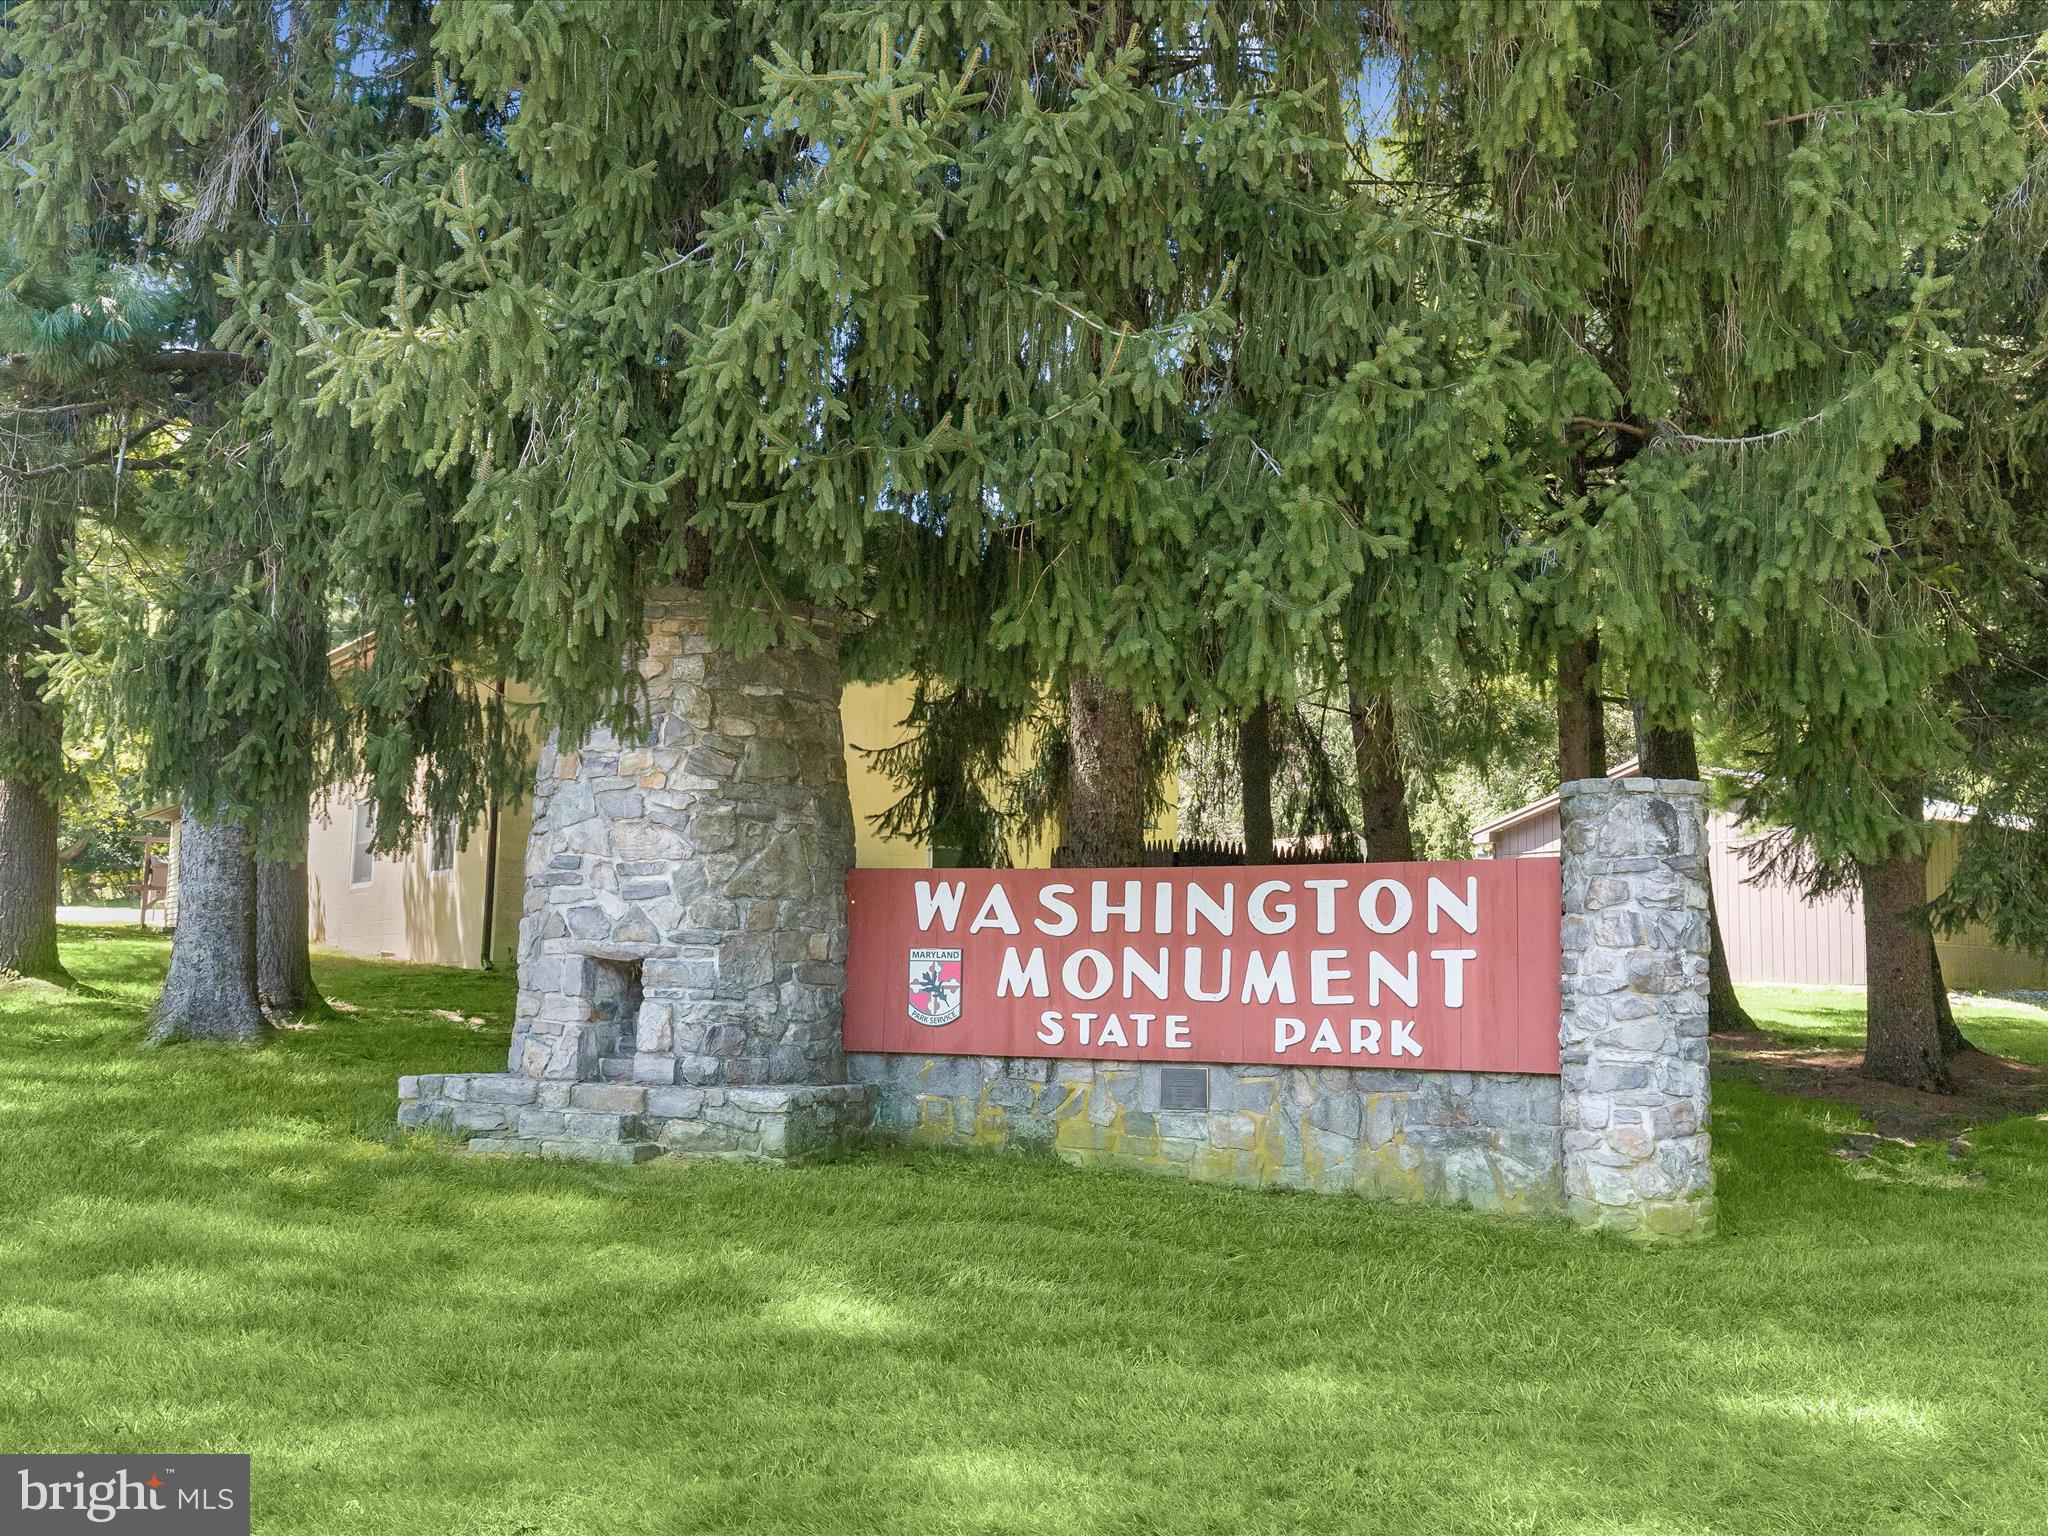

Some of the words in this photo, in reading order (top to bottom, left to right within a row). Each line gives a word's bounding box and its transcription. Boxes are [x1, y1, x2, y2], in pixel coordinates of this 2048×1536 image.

[914, 876, 1478, 937] WASHINGTON
[912, 951, 960, 959] MARYLAND
[997, 946, 1478, 1008] MONUMENT
[911, 1010, 928, 1023] PARK
[929, 1010, 957, 1024] SERVICE
[1036, 1011, 1192, 1048] STATE
[1274, 1016, 1424, 1058] PARK
